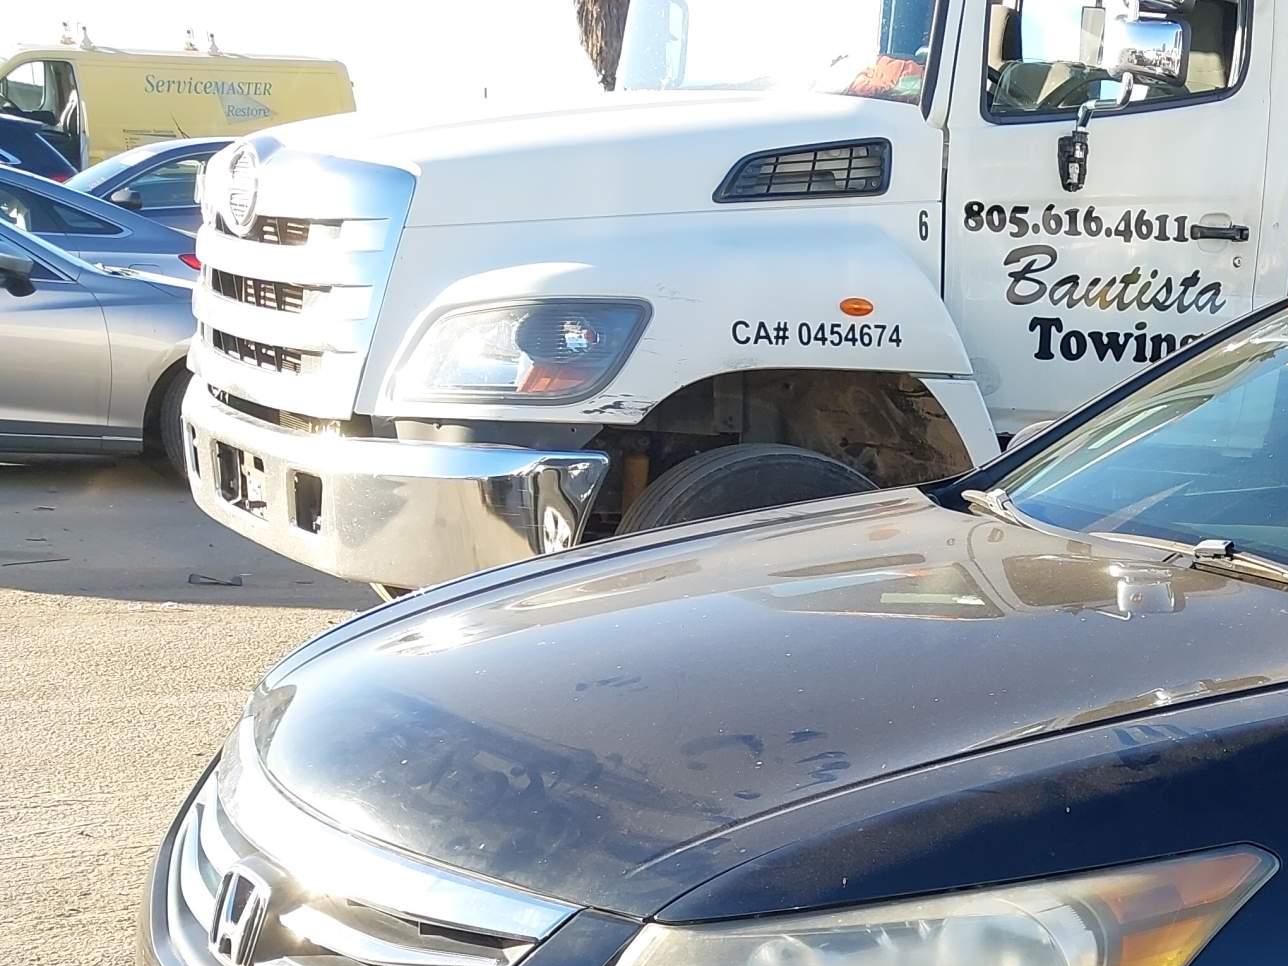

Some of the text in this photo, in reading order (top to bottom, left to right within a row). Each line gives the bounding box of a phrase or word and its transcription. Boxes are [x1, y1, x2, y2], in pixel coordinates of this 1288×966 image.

[226, 104, 271, 118] Restore
[917, 209, 930, 242] 6
[963, 200, 1190, 243] 805.616.4611
[1003, 243, 1228, 315] Bautista
[731, 319, 903, 348] CA# 0454674
